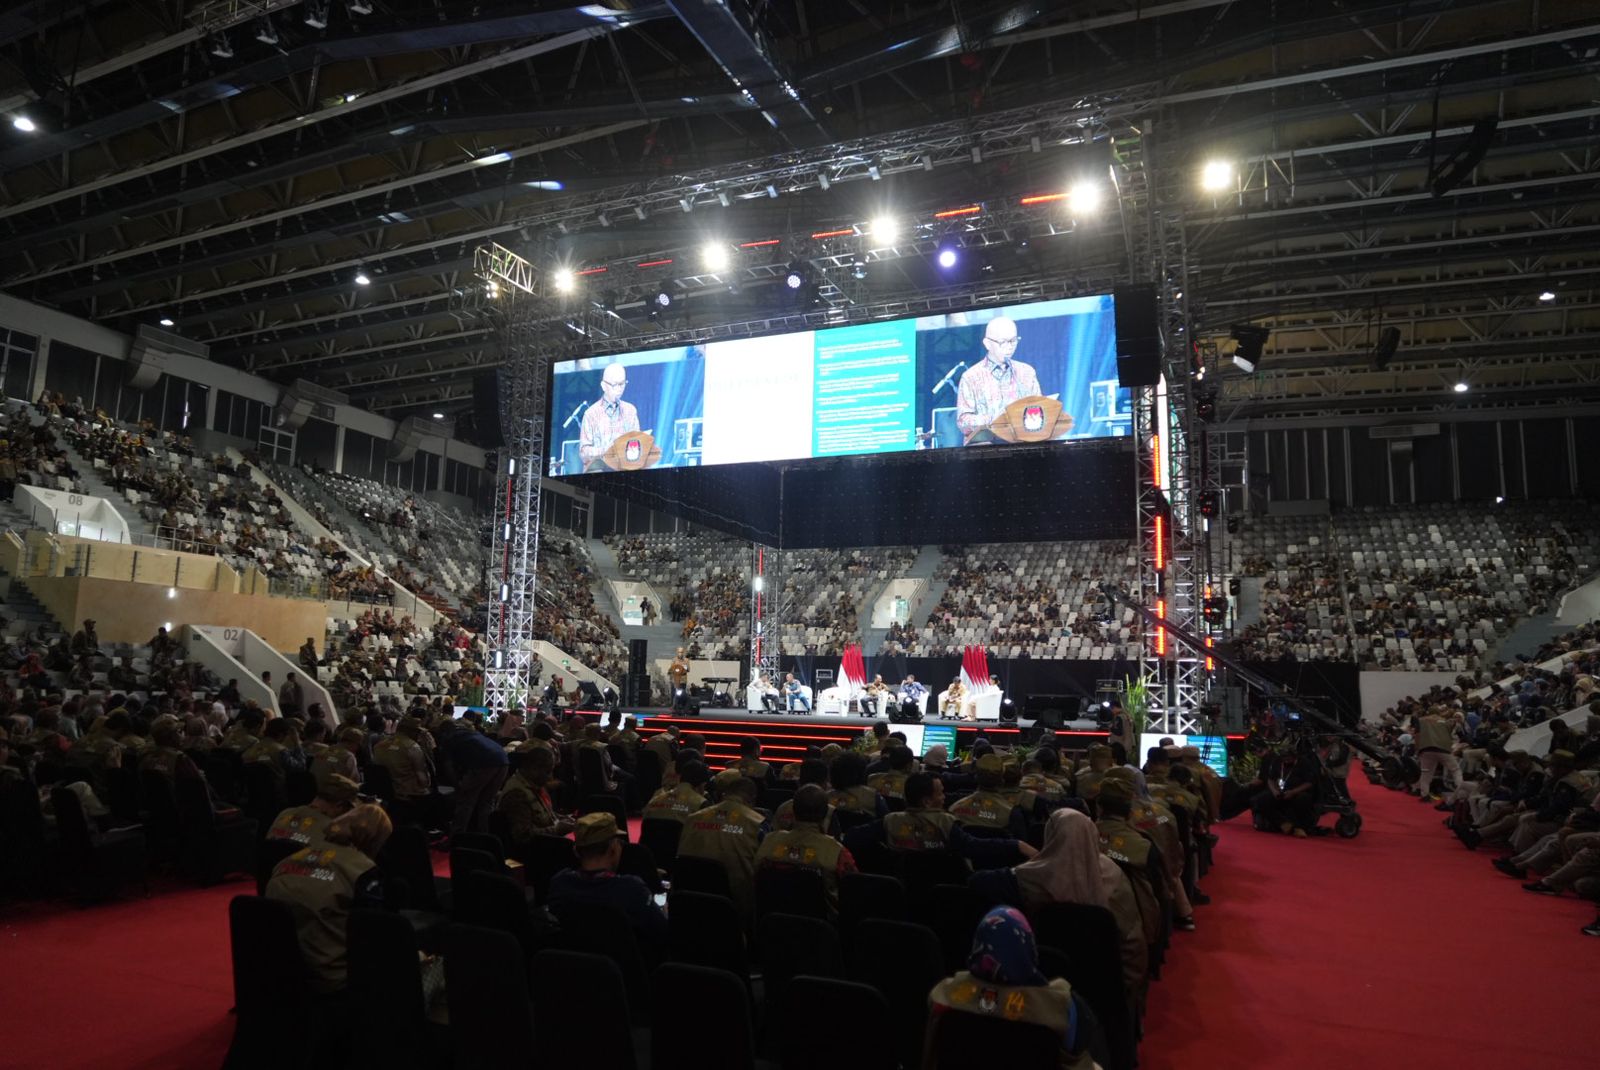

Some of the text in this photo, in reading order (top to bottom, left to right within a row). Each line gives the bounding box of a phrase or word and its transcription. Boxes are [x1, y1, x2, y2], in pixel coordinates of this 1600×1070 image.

[69, 495, 83, 505] 08
[224, 629, 238, 640] 02
[722, 824, 744, 834] 2024
[1106, 849, 1129, 862] 2024
[310, 868, 335, 881] 2024
